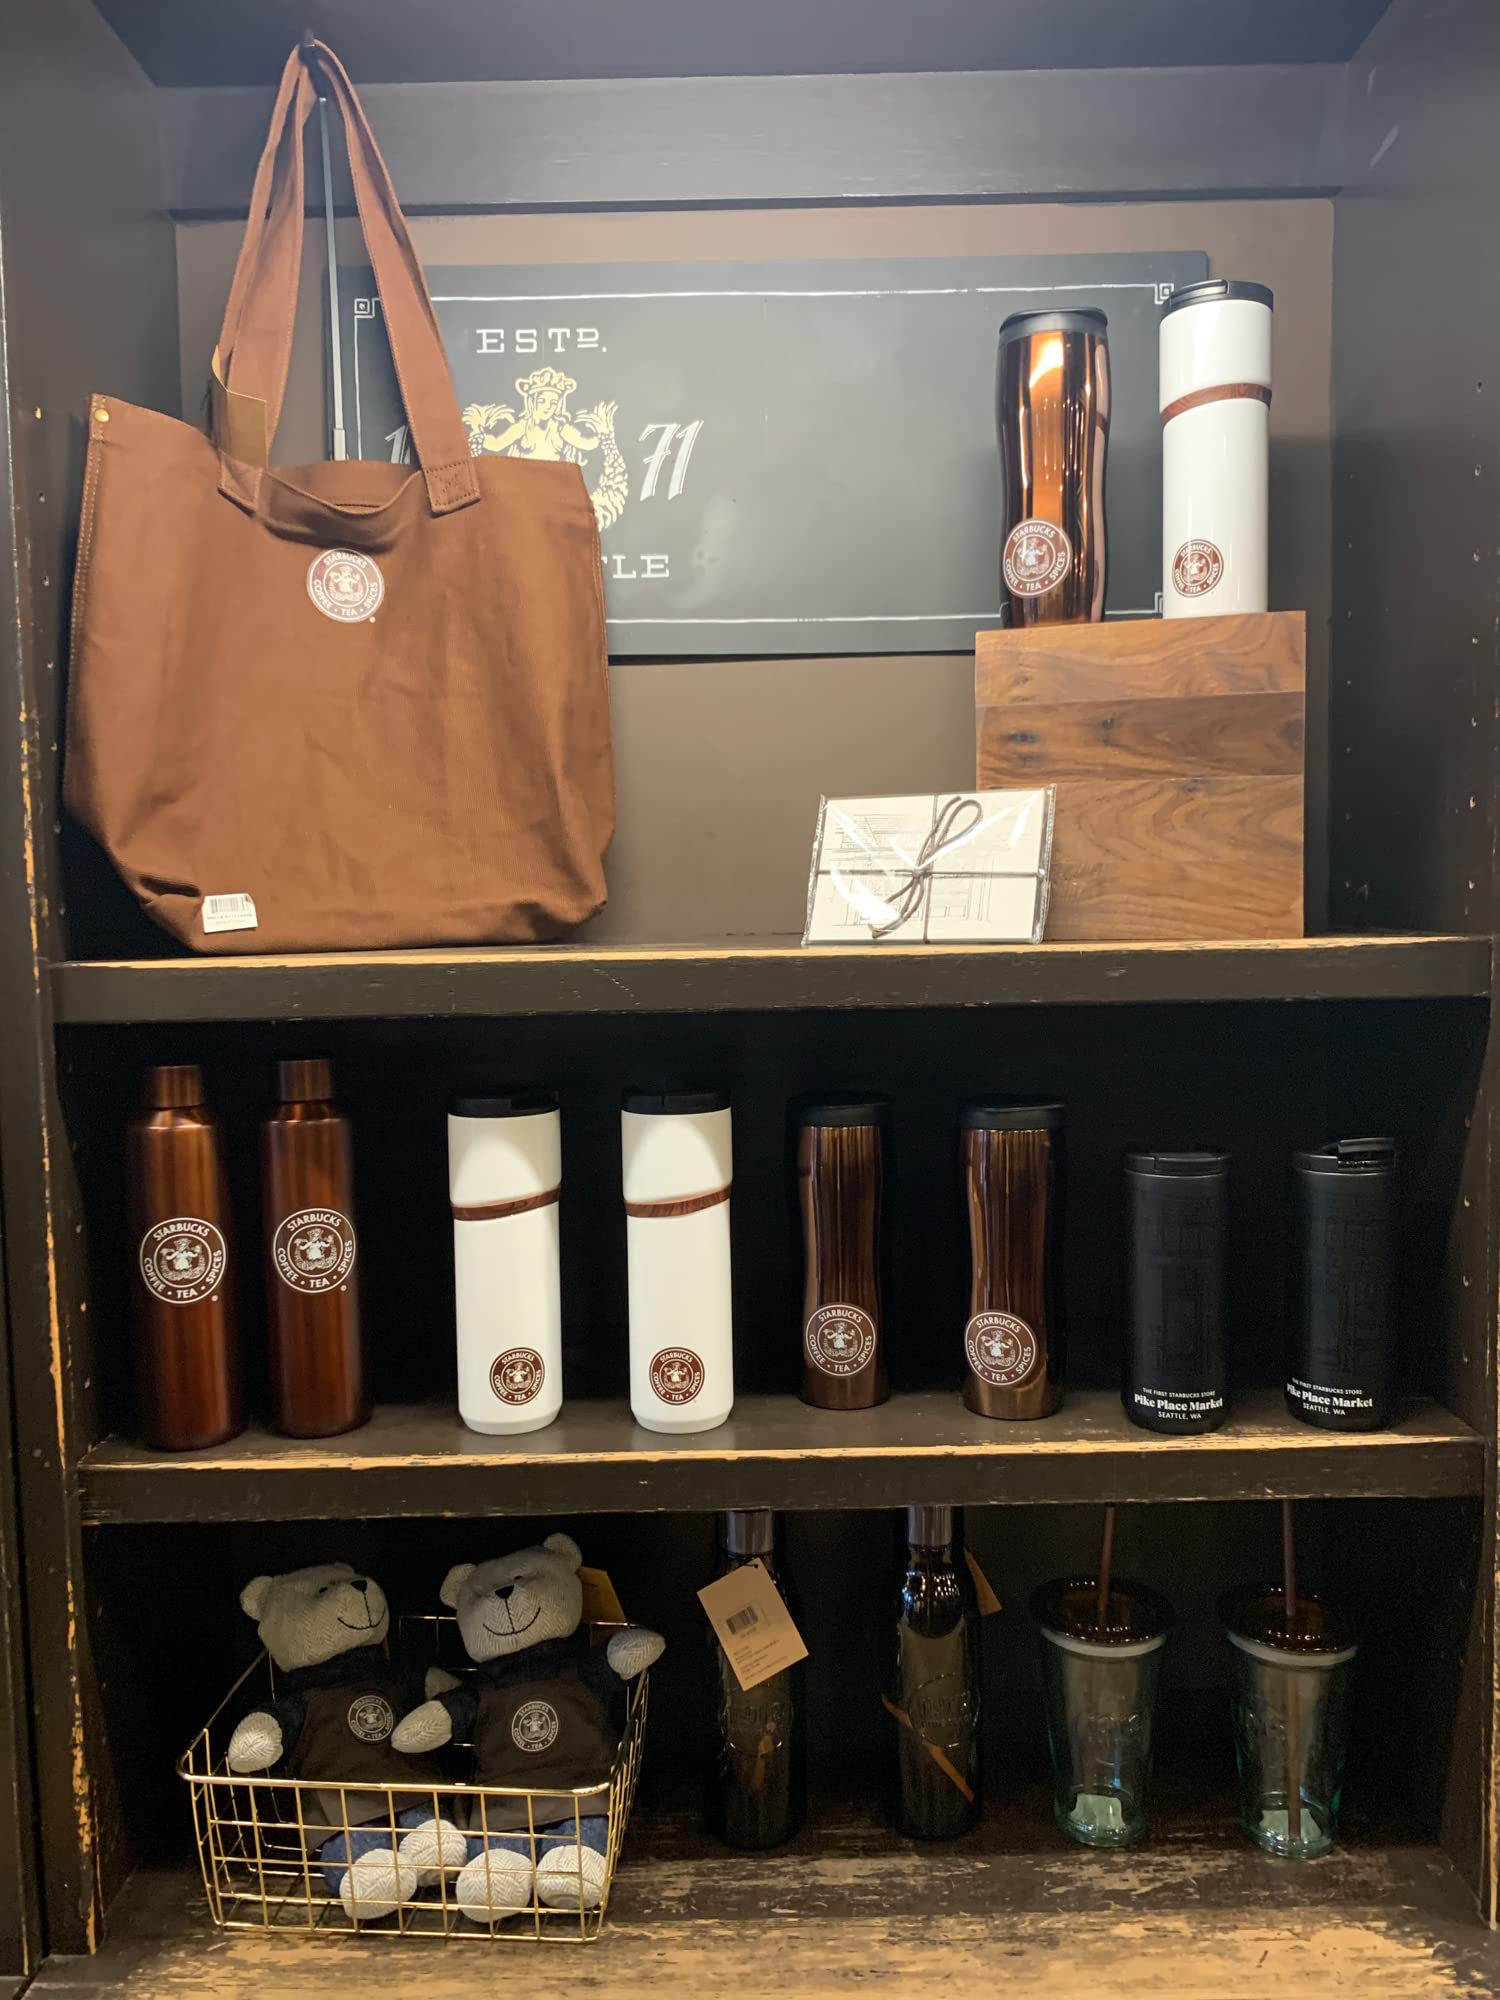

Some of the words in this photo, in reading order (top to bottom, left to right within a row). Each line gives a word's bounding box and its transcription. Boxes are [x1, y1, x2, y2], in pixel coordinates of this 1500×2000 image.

[639, 419, 704, 501] 71
[1012, 524, 1056, 543] STARBUCKS
[1180, 543, 1213, 557] STARBUCKS
[323, 551, 368, 569] STARBUCKS
[1004, 558, 1019, 588] COFFEE
[1026, 582, 1042, 592] TEA
[1049, 551, 1066, 581] SPICES
[1174, 568, 1185, 590] COFFEE
[1188, 585, 1201, 593] TEA
[1206, 562, 1219, 585] SPICES
[313, 579, 333, 609] COFFEE
[341, 608, 358, 616] TEA
[363, 581, 378, 609] SPICES
[287, 1213, 342, 1232] STARBUCKS
[153, 1223, 211, 1242] STARBUCKS
[276, 1247, 298, 1283] COFFEE
[309, 1278, 331, 1288] TEA
[337, 1239, 353, 1275] SPICES
[143, 1257, 166, 1293] COFFEE
[176, 1288, 198, 1299] TEA
[205, 1249, 223, 1285] SPICES
[817, 1309, 863, 1324] STARBUCKS
[975, 1315, 1022, 1333] STARBUCKS
[501, 1352, 535, 1365] STARBUCKS
[659, 1352, 693, 1363] STARBUCKS
[808, 1333, 825, 1364] COFFEE
[833, 1364, 851, 1373] TEA
[857, 1335, 872, 1363] SPICES
[967, 1339, 983, 1373] COFFEE
[991, 1372, 1008, 1382] TEA
[1015, 1345, 1032, 1375] SPICES
[493, 1374, 508, 1397] COFFEE
[530, 1369, 541, 1393] SPICES
[652, 1371, 665, 1395] COFFEE
[689, 1371, 701, 1394] SPICES
[1142, 1387, 1153, 1395] THE
[1153, 1389, 1168, 1397] FIRST
[1201, 1390, 1216, 1398] STORE
[1312, 1384, 1344, 1395] STARBUCKS
[1134, 1393, 1156, 1409] Pike
[1157, 1398, 1188, 1411] Place
[1189, 1397, 1223, 1411] Market
[1286, 1383, 1302, 1398] Pike
[1302, 1390, 1332, 1405] Place
[1332, 1395, 1373, 1408] Market
[1190, 1412, 1202, 1420] WA
[1333, 1408, 1346, 1416] WA
